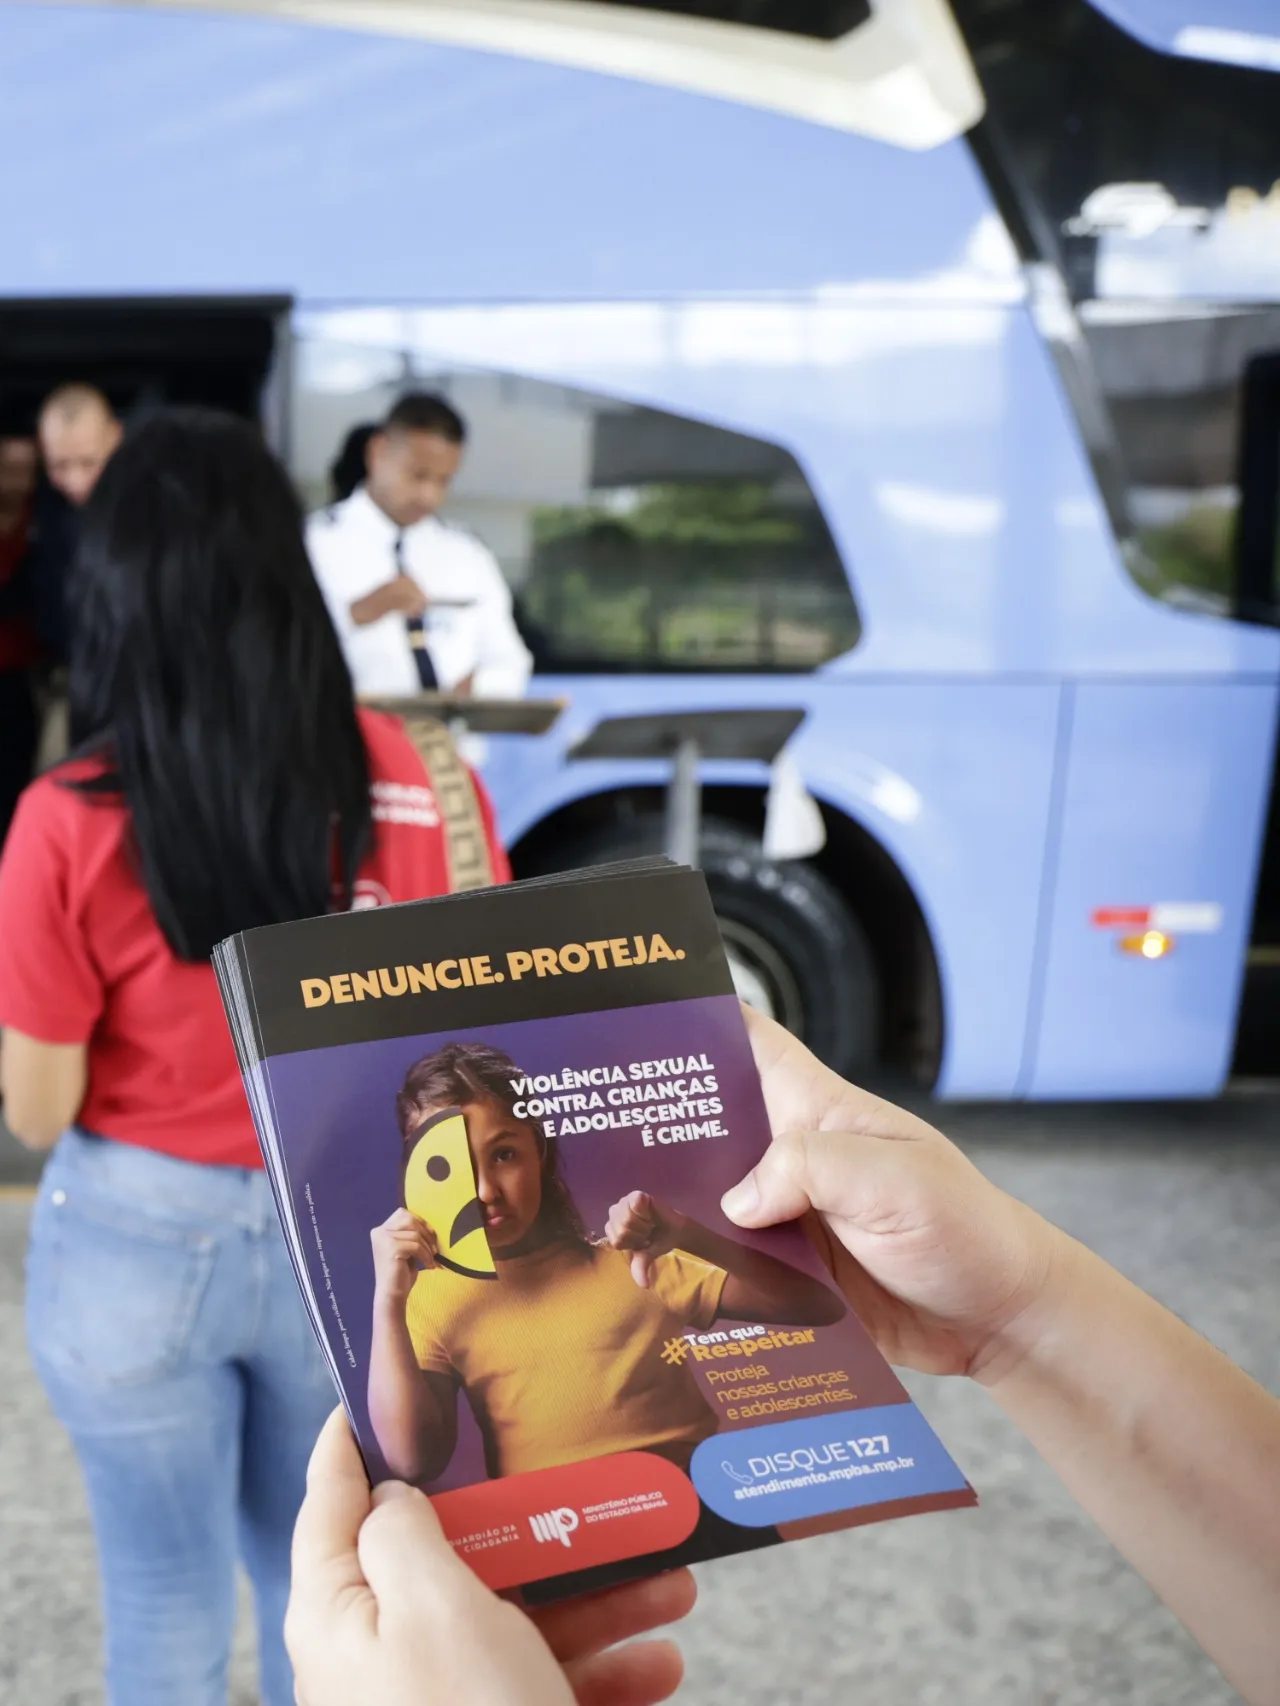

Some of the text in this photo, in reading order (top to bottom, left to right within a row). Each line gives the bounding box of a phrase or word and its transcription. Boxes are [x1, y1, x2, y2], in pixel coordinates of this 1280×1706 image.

[300, 933, 686, 1008] DENUNCIE. PROTEJA.
[510, 1053, 715, 1096] VIOLÊNCIA SEXUAL
[512, 1075, 719, 1119] CONTRA CRIANÇAS
[543, 1097, 724, 1138] E ADOLESCENTES
[641, 1119, 729, 1147] É CRIME.
[690, 1328, 816, 1362] Respeitar
[729, 1325, 766, 1341] que
[705, 1364, 770, 1386] Proteja
[716, 1369, 849, 1403] nossas crianças
[726, 1387, 858, 1420] e adolescentes.
[747, 1434, 891, 1478] DISQUE 127
[733, 1455, 915, 1500] atendimento.mpba.mp.br
[581, 1498, 628, 1514] MINISTÉRIO
[585, 1499, 668, 1523] DO ESTADO DA BAHIA
[464, 1533, 520, 1553] CIDADANIA
[502, 1524, 517, 1534] DA
